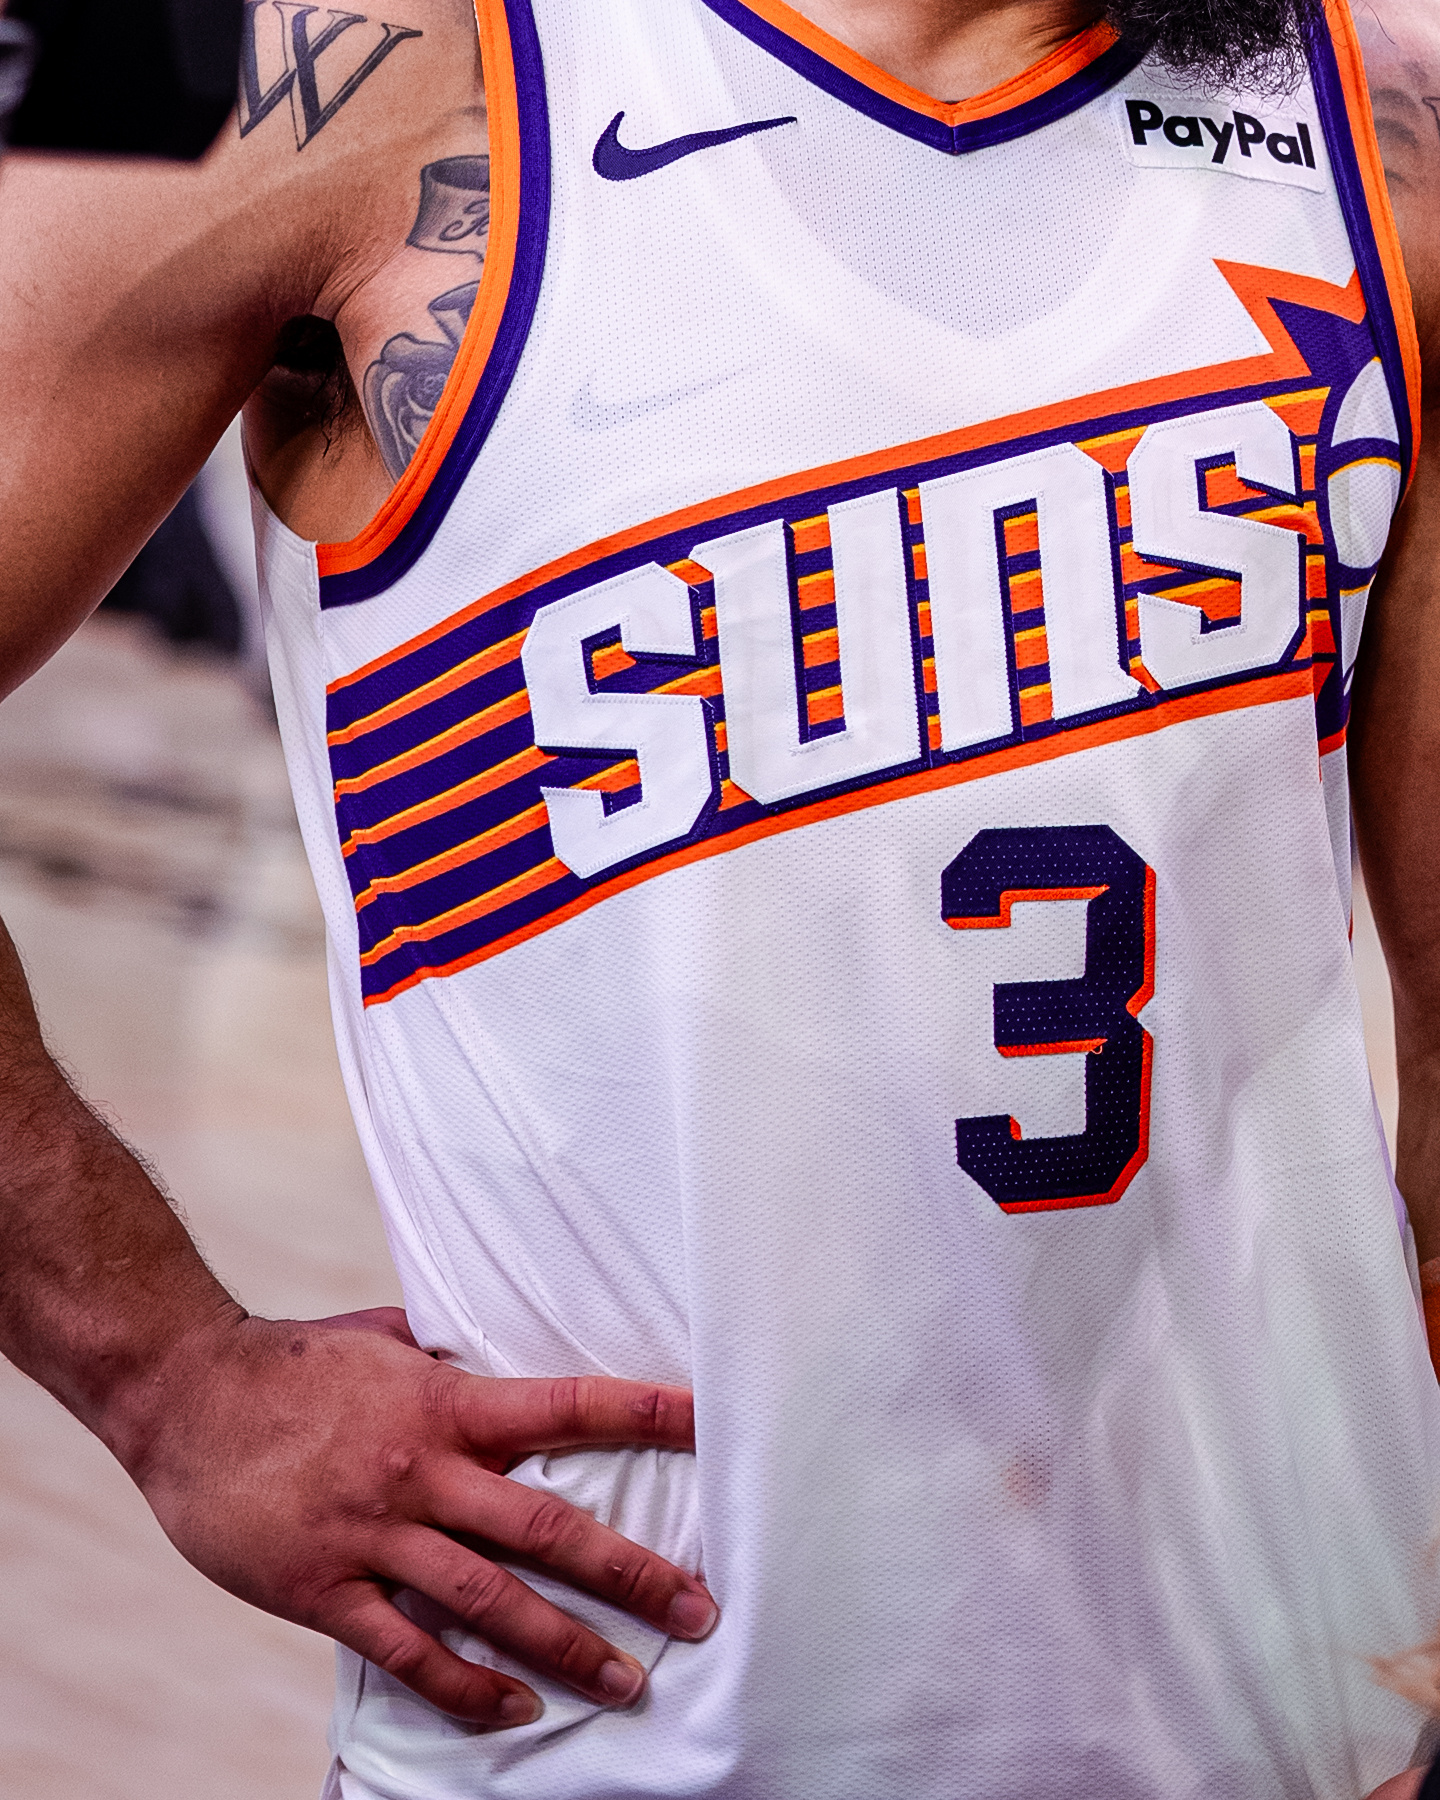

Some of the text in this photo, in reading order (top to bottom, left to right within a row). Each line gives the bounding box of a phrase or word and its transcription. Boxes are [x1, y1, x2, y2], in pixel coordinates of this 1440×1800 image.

[1125, 100, 1316, 169] PayPal
[520, 400, 1306, 880] SUNS
[941, 824, 1157, 1214] 3
